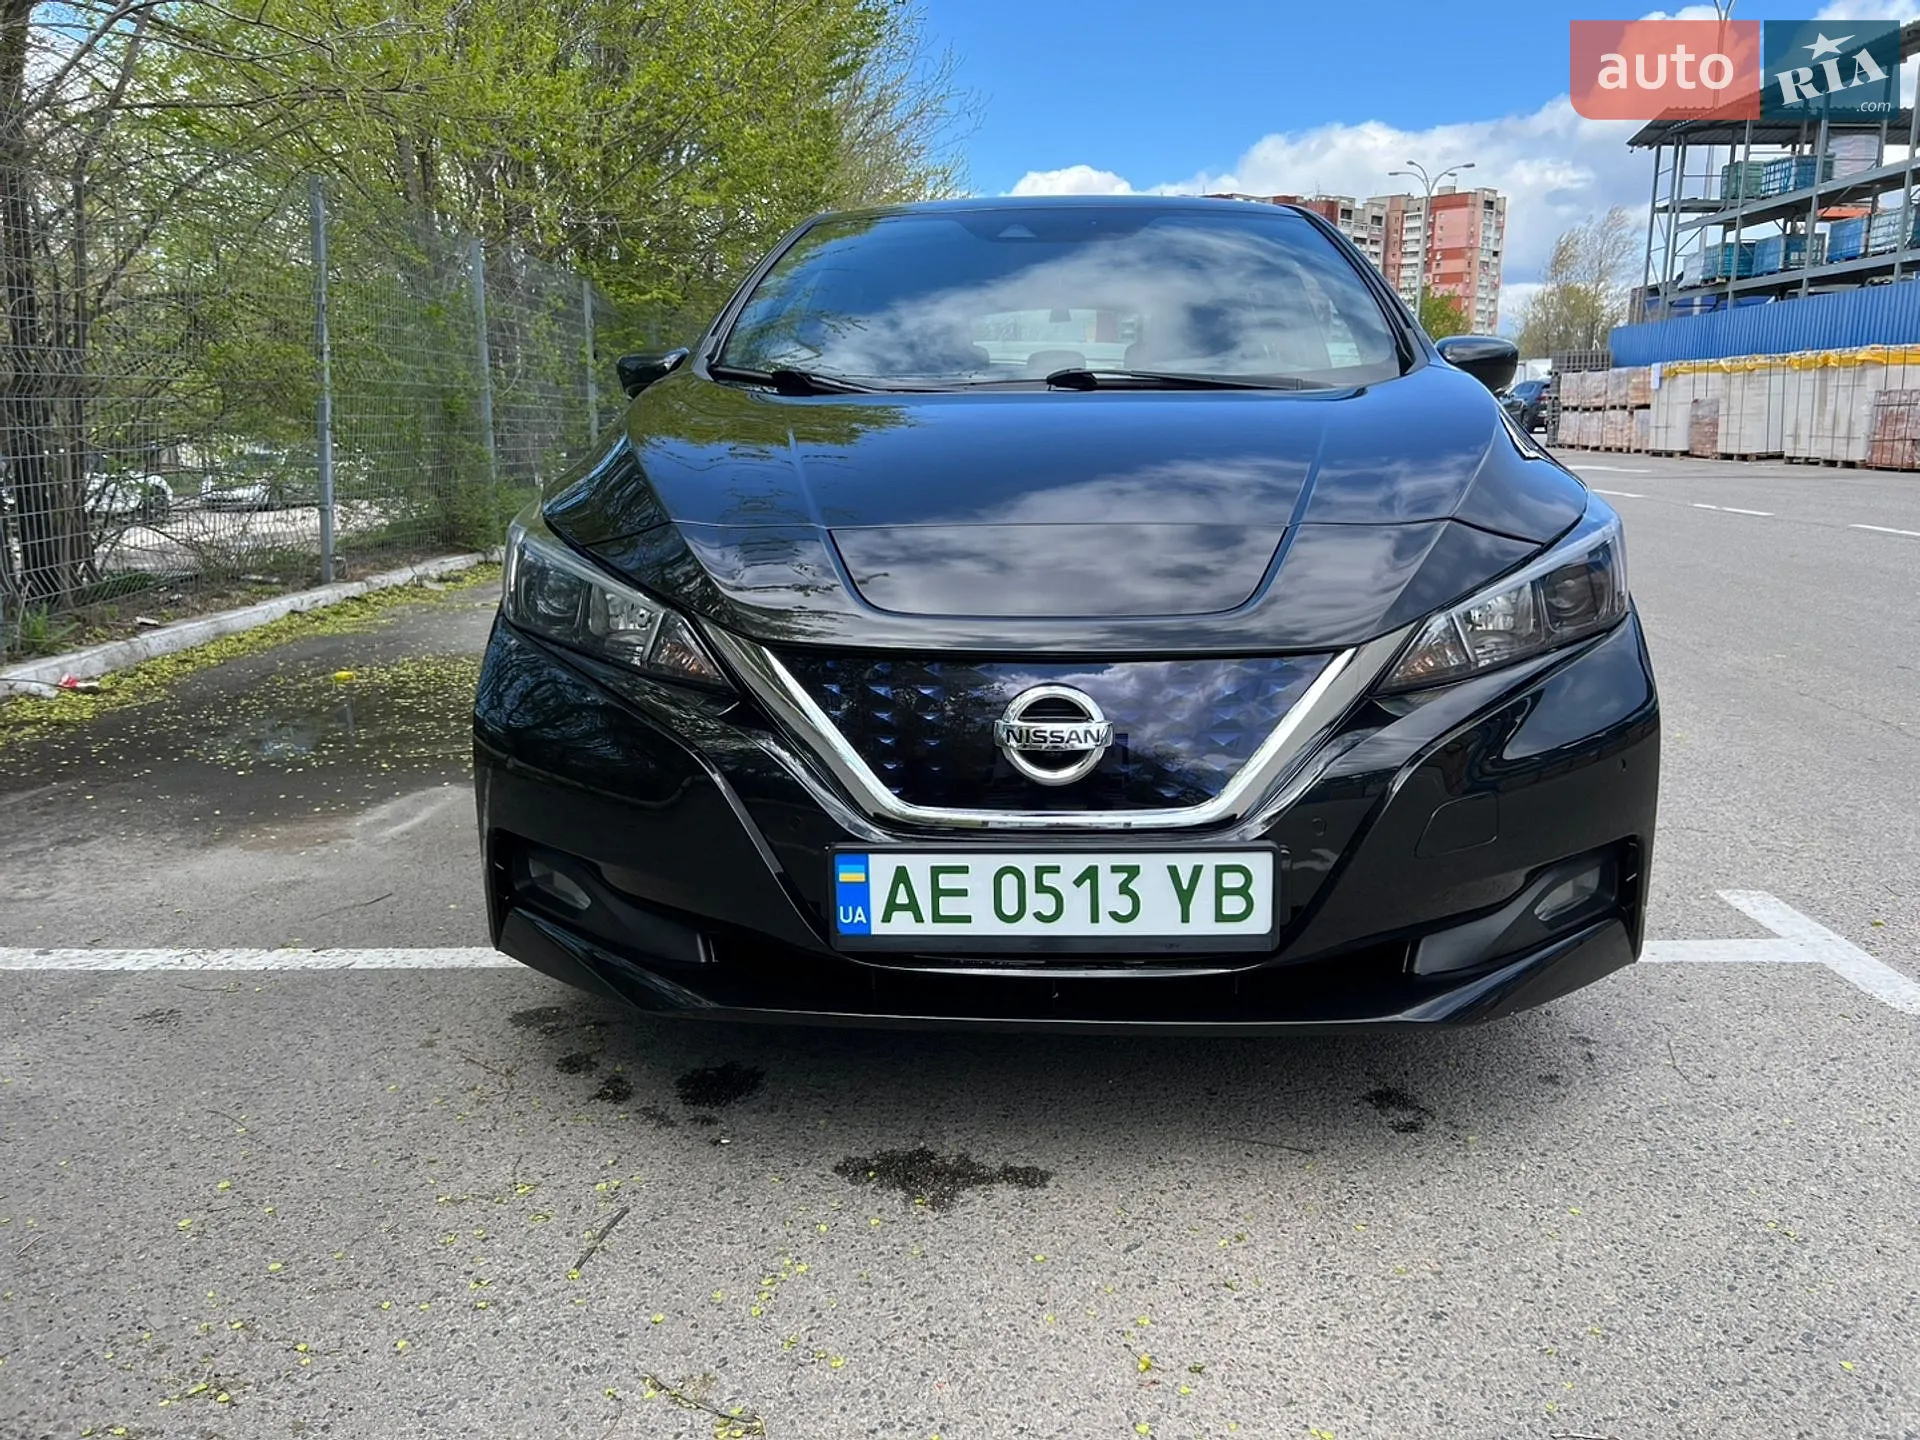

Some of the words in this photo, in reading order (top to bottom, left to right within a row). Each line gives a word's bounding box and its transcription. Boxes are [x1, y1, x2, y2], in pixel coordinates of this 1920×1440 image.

[1006, 729, 1100, 744] NISSAN
[880, 864, 972, 924] AE
[993, 864, 1142, 924] 0513
[1167, 864, 1255, 924] YB
[840, 905, 867, 924] UA
